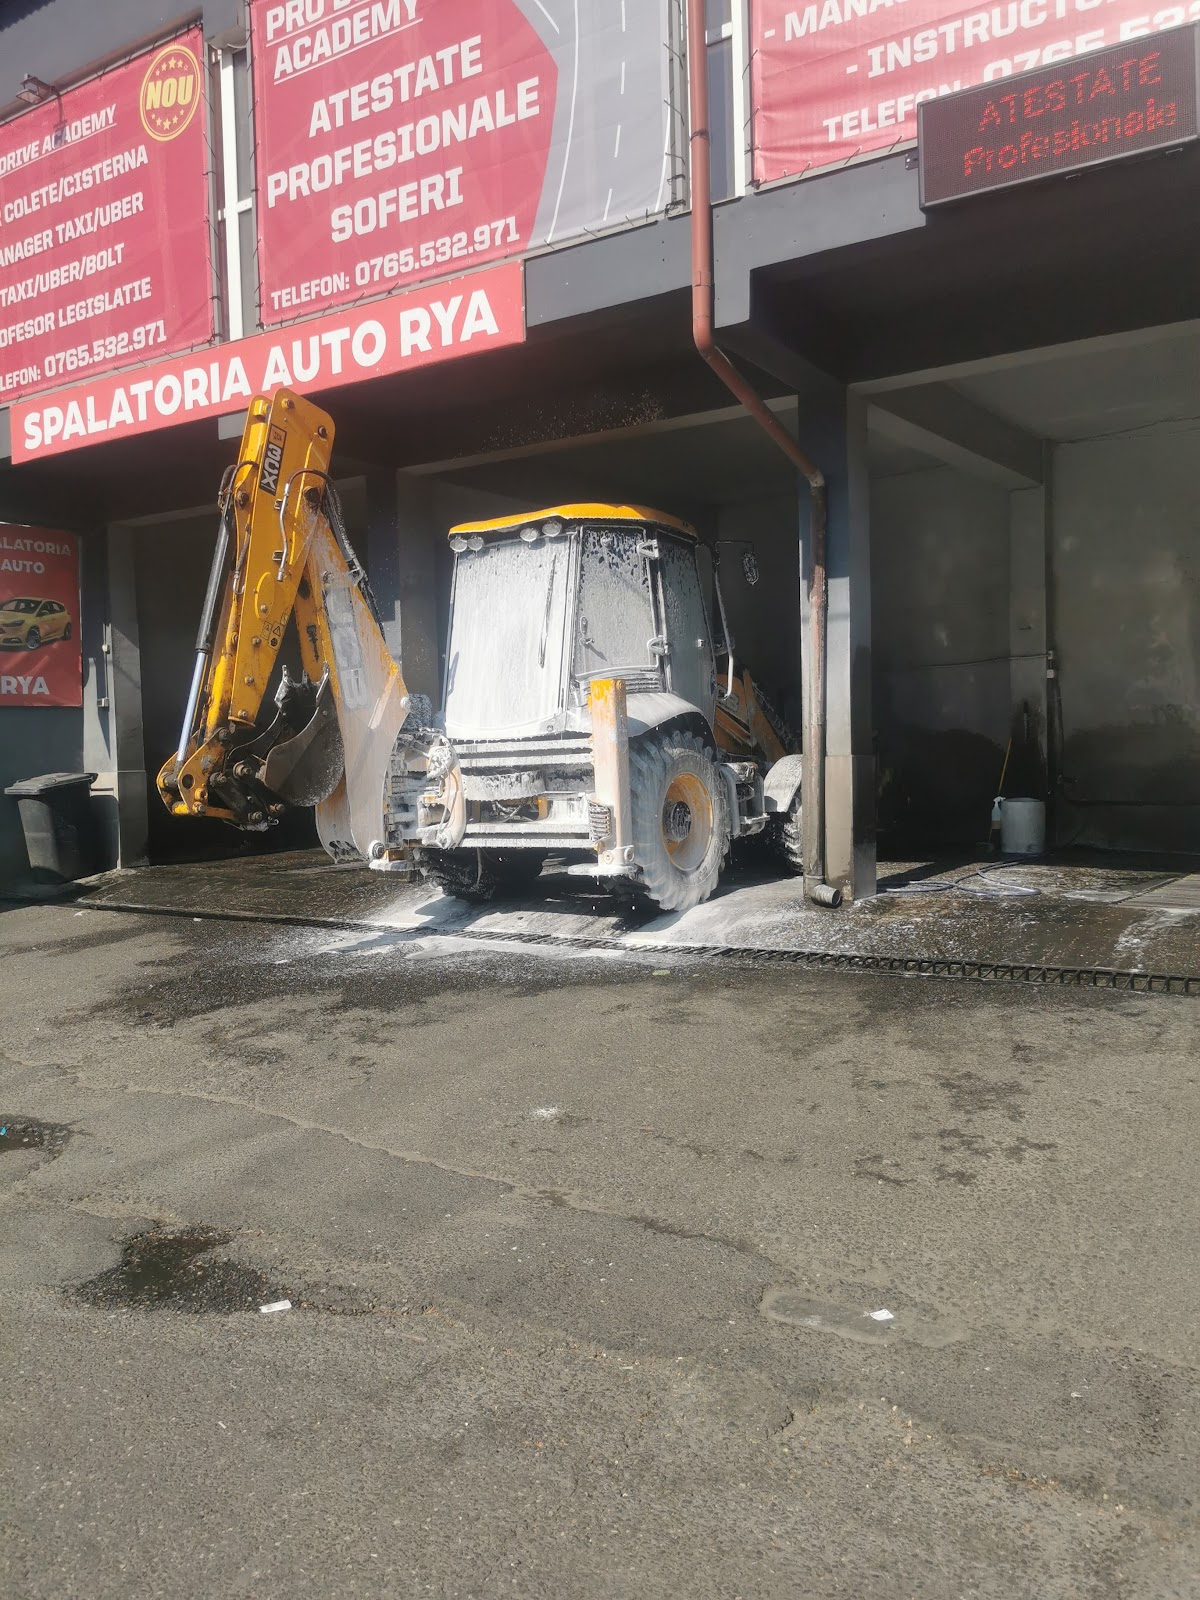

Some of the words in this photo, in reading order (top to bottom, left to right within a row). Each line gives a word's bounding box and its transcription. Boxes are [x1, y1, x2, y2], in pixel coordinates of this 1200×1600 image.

[266, 0, 325, 42] PRO
[273, 0, 417, 80] ACADEMY
[785, 0, 909, 42] MAN
[144, 75, 195, 111] NOU
[308, 34, 483, 139] ATESTATE
[977, 51, 1162, 133] ATESTATE
[0, 140, 40, 175] DRIVE
[42, 103, 117, 155] ACADEMY
[266, 76, 541, 209] PROFESIONALE
[4, 145, 149, 224] COLETE/CISTERNA
[55, 191, 144, 244] TAXI/UBER
[330, 165, 464, 244] SOFERI
[0, 242, 125, 308] TAXI/UBER/BOLT
[270, 271, 351, 311] TELEFON:
[354, 215, 520, 287] 0765.532.971
[58, 276, 152, 328] LEGISLATIE
[23, 360, 253, 451] SPALATORIA
[261, 319, 387, 393] AUTO
[399, 289, 500, 358] RYA
[44, 319, 167, 378] 0765.532.971
[0, 537, 72, 556] LATORIA
[0, 558, 46, 575] AUTO
[0, 675, 50, 695] RYA
